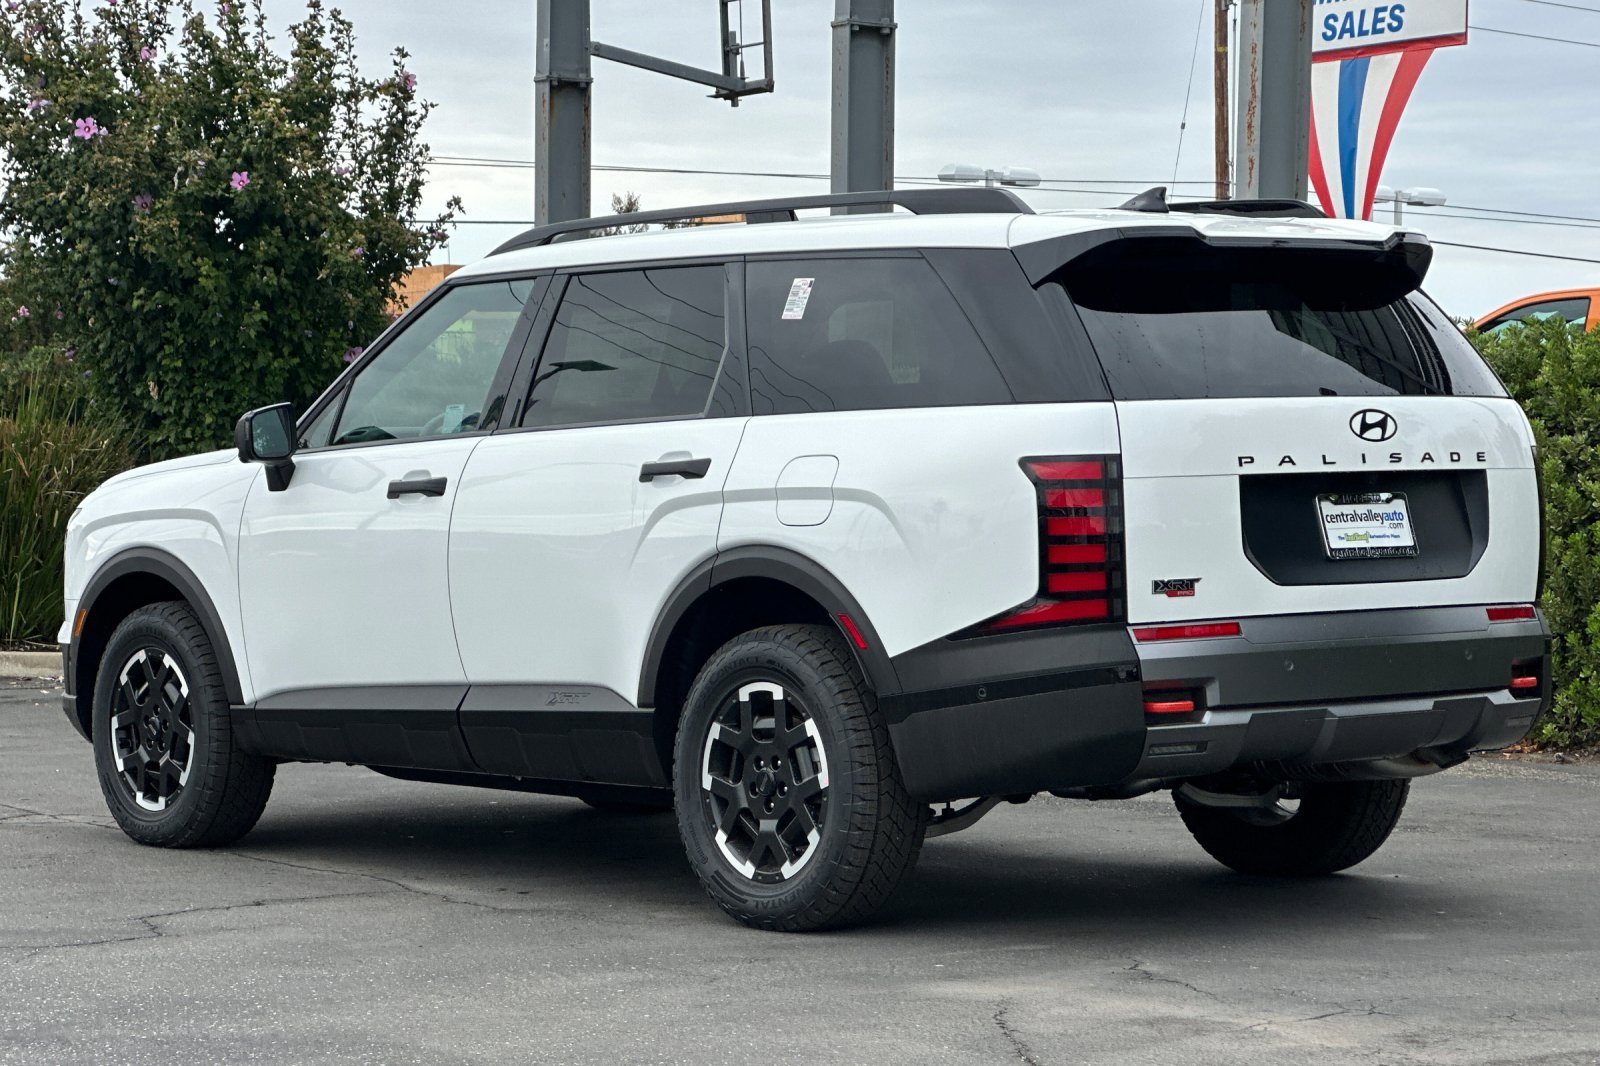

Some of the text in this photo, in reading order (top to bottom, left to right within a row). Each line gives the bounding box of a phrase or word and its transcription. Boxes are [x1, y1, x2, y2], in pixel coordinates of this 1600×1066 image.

[1321, 4, 1405, 42] SALES
[1237, 451, 1487, 467] PALISADE
[1325, 509, 1404, 524] centralvalleyauto
[1152, 577, 1202, 594] XRT
